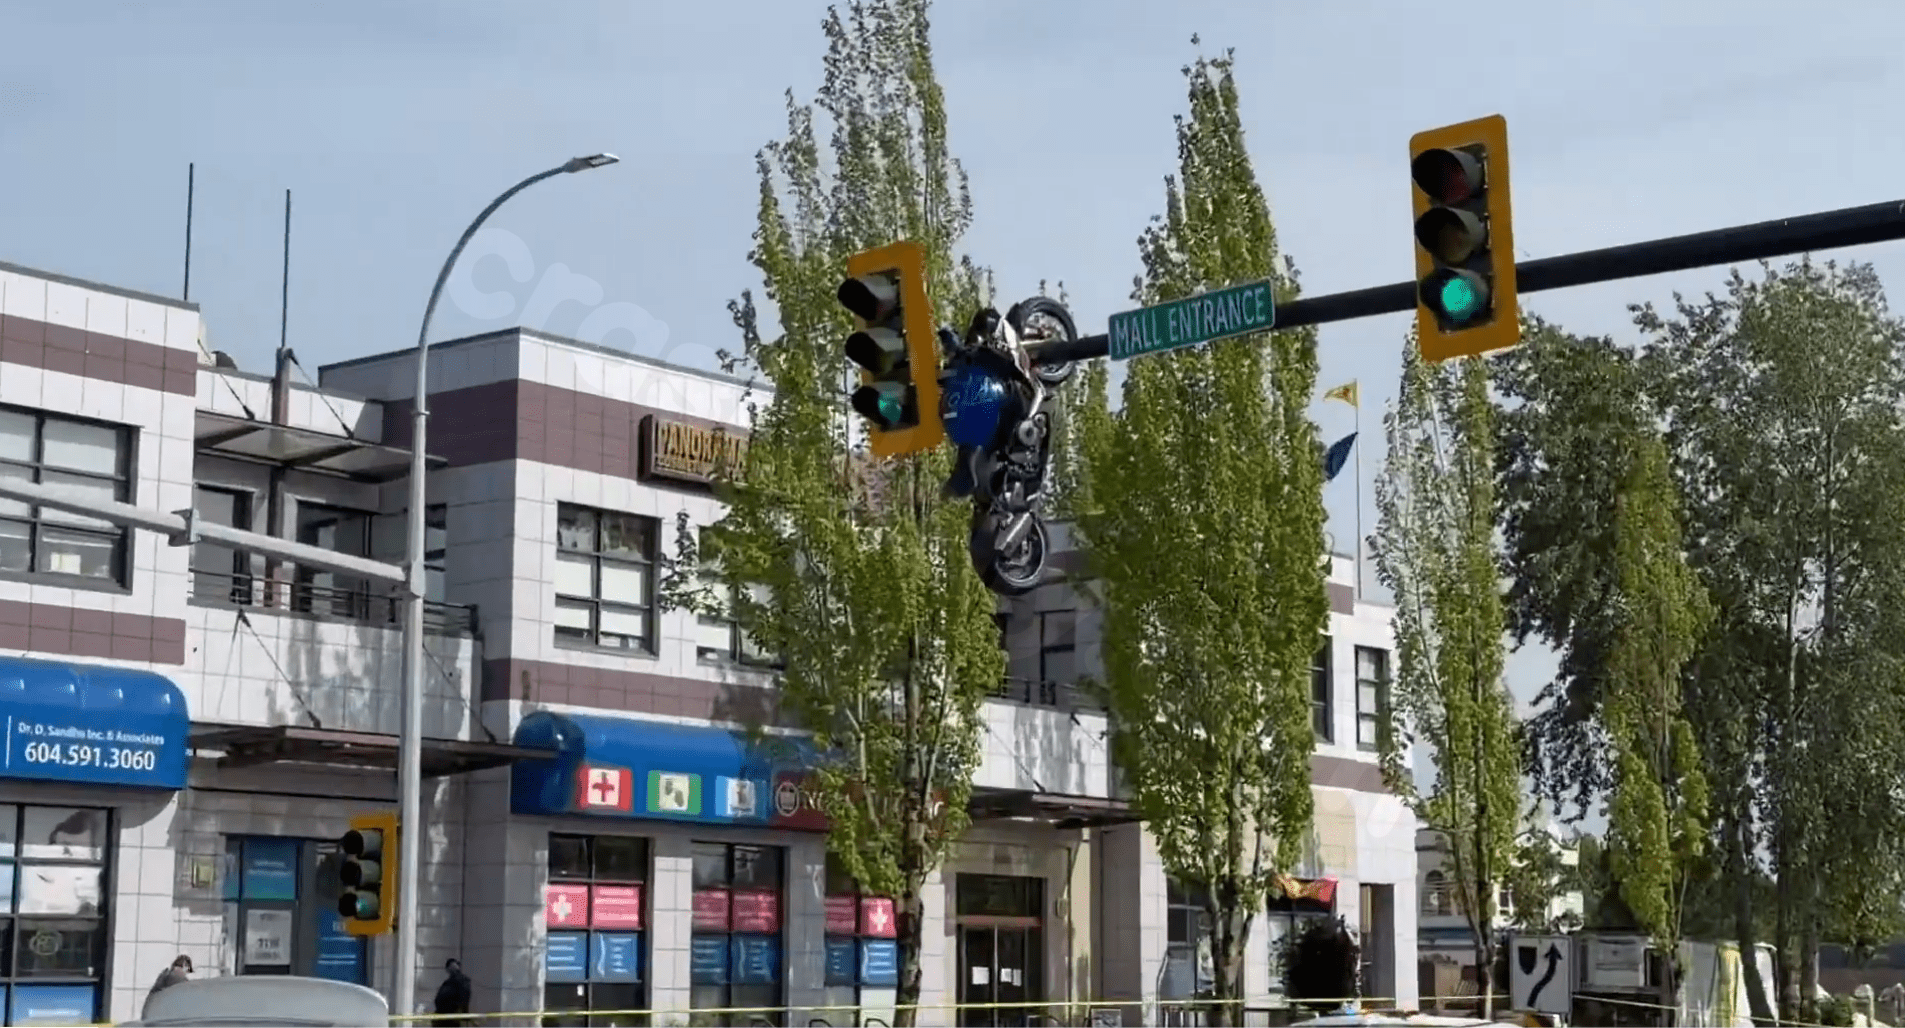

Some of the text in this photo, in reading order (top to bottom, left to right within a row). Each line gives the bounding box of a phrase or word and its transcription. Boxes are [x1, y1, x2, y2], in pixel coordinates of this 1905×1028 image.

[1115, 287, 1266, 354] MALL ENTRANCE
[25, 742, 156, 771] 604.591.3060
